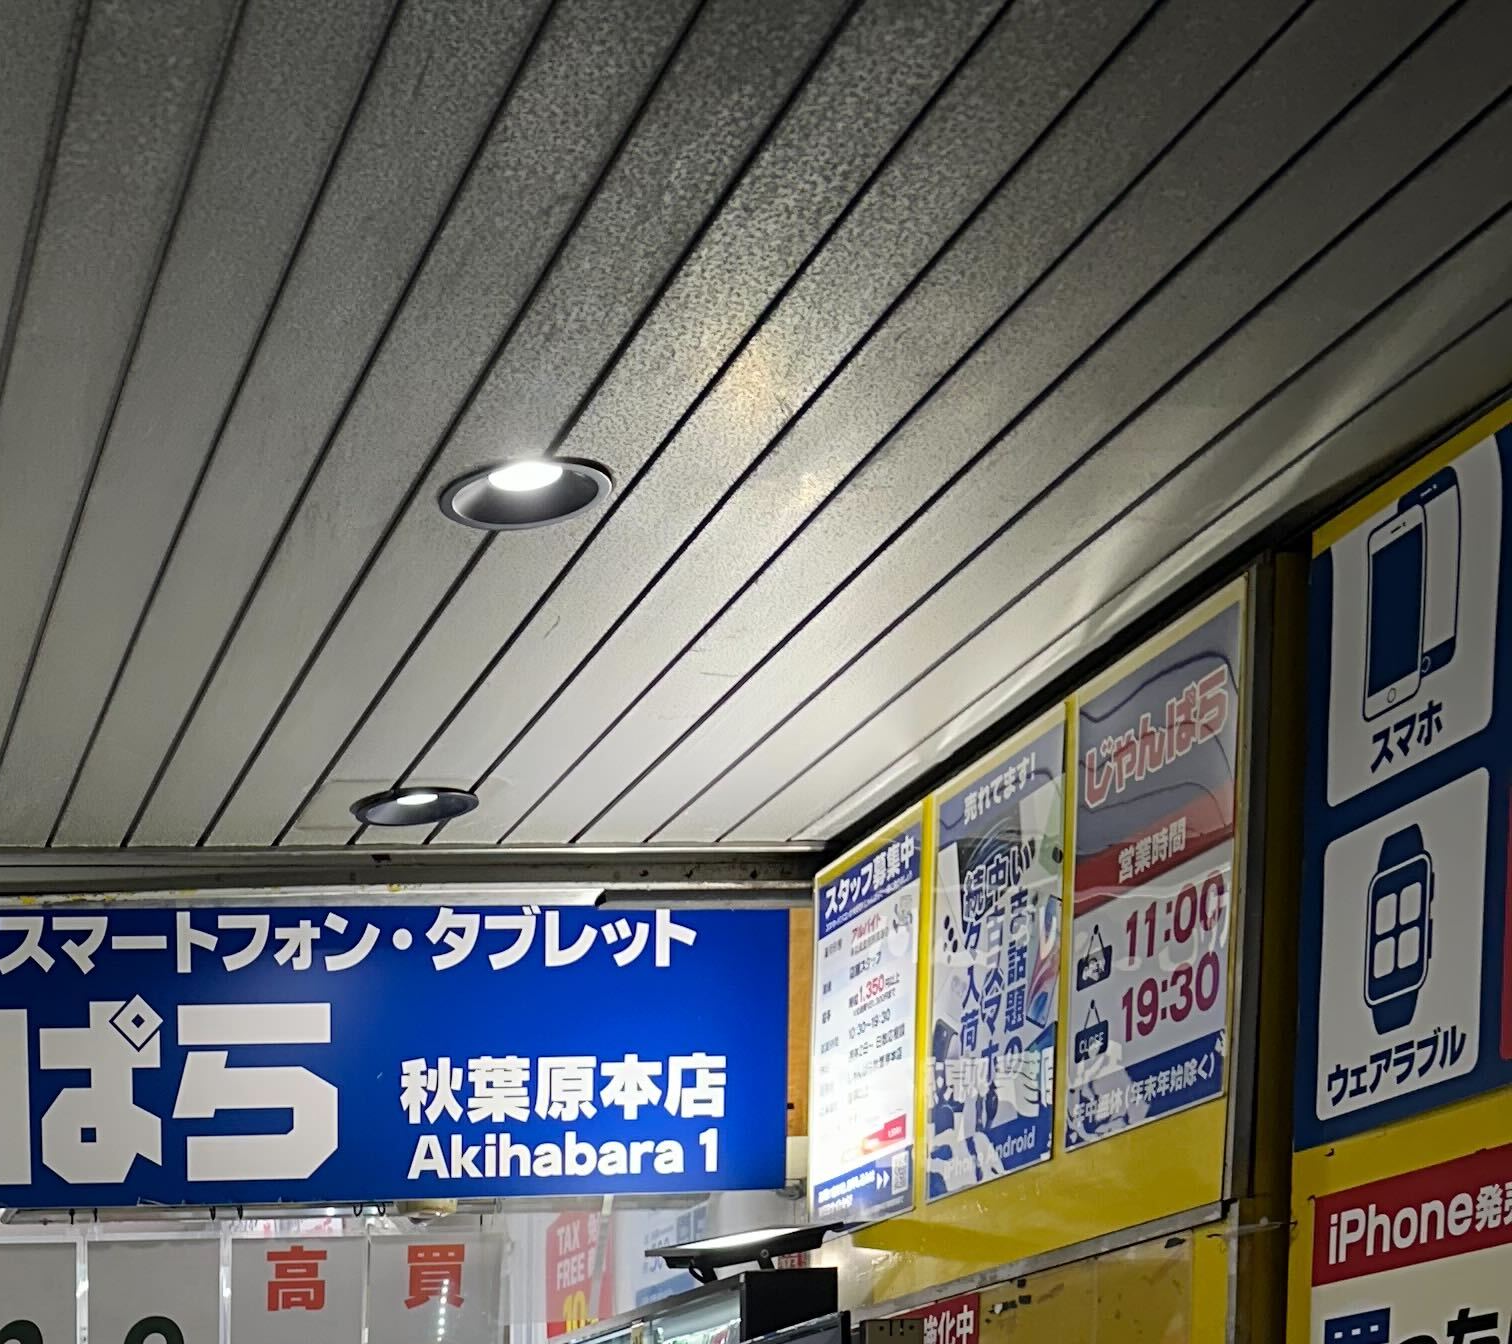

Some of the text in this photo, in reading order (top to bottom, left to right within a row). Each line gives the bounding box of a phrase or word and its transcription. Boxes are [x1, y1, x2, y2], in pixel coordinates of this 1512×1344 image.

[1085, 664, 1229, 808] じゃんぱら
[1370, 700, 1444, 774] スマホ
[824, 835, 916, 920] スタッフ募集中
[1118, 816, 1187, 884] 営業時間
[1125, 869, 1226, 967] 11:00
[1121, 951, 1221, 1043] 19:30
[399, 1052, 728, 1127] 秋葉原本店
[1328, 1025, 1467, 1107] ウェアラブル
[407, 1129, 720, 1180] Akihabara 1
[556, 1258, 586, 1290] FREE
[557, 1225, 581, 1250] TAX
